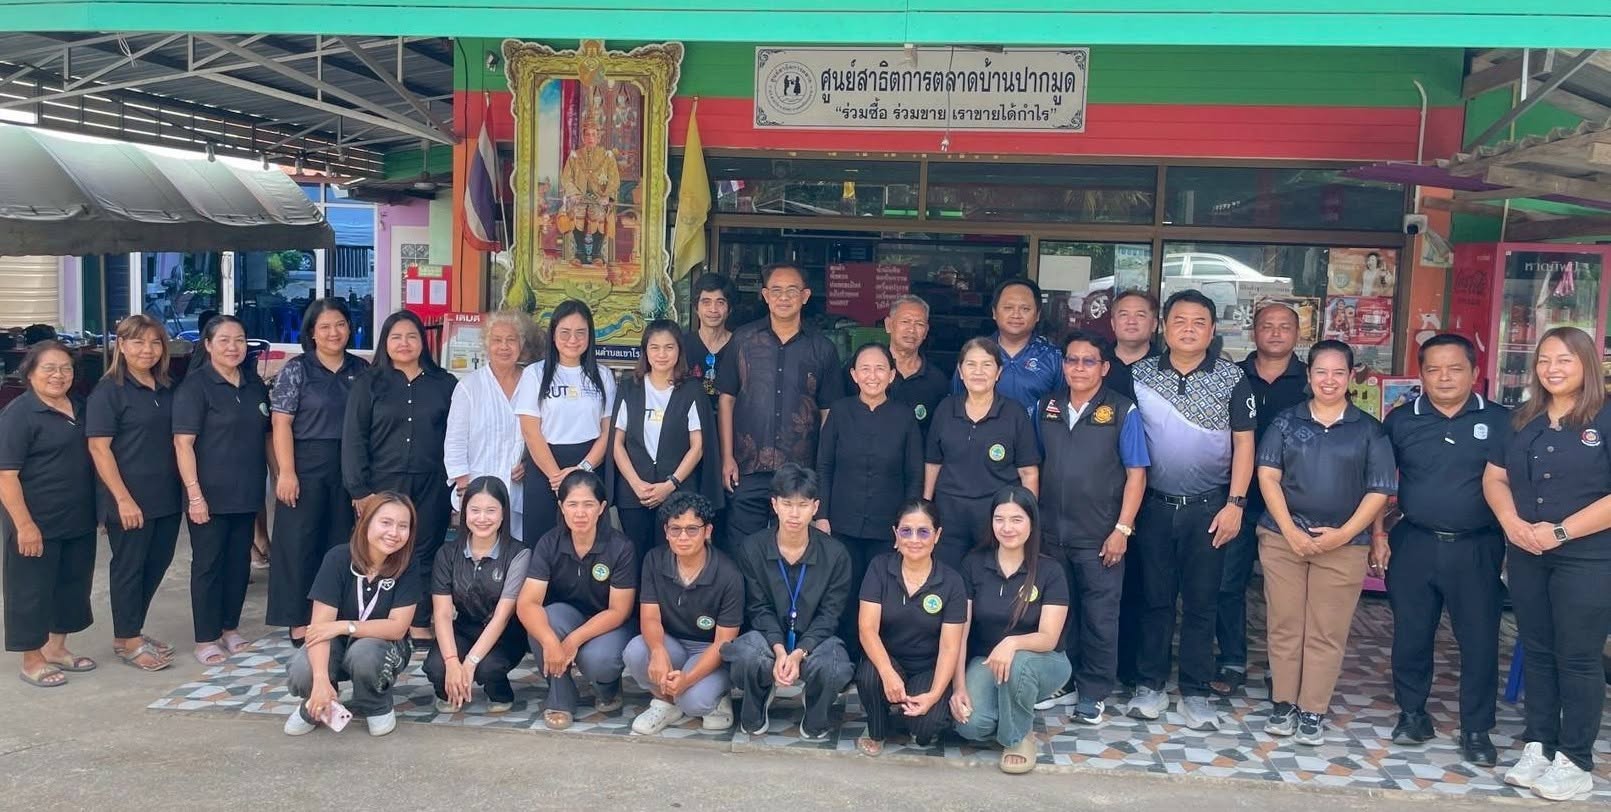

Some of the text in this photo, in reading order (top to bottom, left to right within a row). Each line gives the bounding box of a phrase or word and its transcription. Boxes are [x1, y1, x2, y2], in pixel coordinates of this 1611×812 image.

[820, 57, 1076, 105] ศูนย์สาธิตการตลาดบ้านปากมูด
[835, 97, 888, 120] “ร่วมซื้อ
[892, 103, 947, 121] ร่วมขาย
[951, 102, 1057, 122] เราขายได้กำไร”
